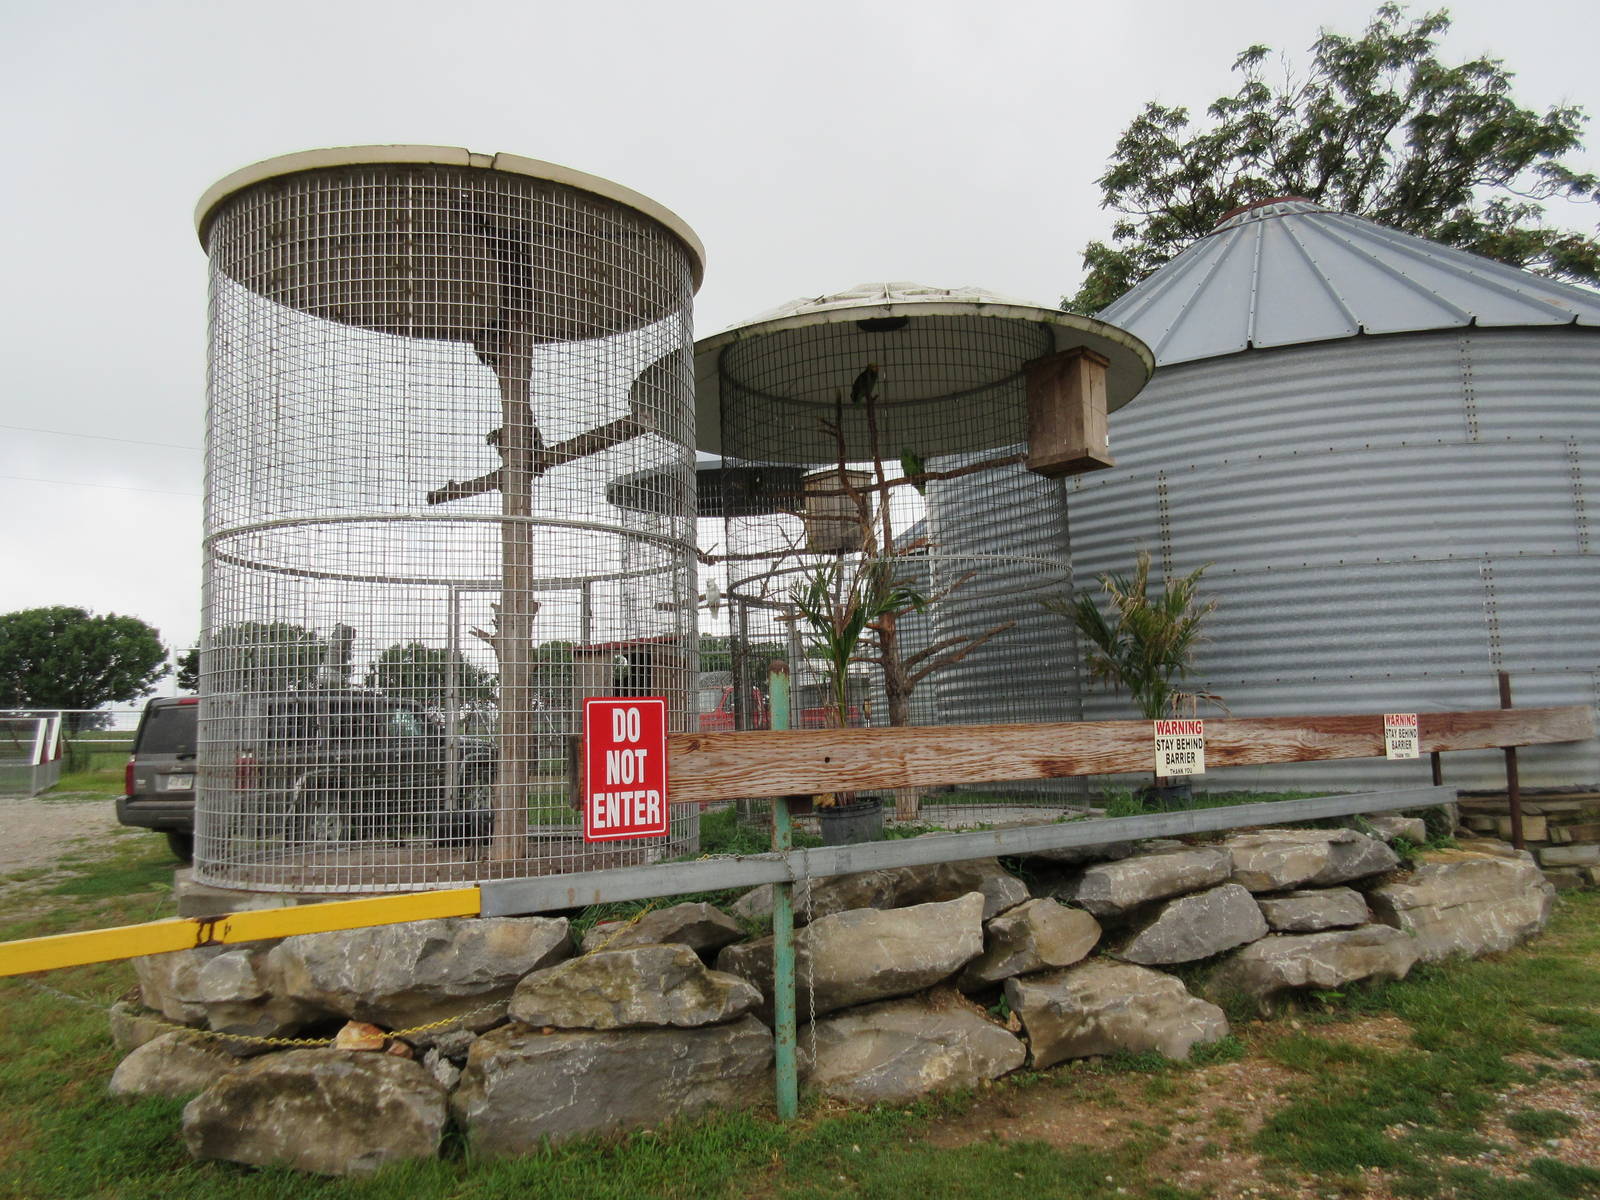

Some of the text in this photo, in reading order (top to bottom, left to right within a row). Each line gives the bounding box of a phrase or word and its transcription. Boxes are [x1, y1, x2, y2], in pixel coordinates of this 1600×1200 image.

[612, 707, 640, 742] DO
[1385, 714, 1416, 726] WARNING
[1156, 721, 1202, 735] WARNING
[1156, 738, 1203, 751] STAY BEHIND
[1166, 752, 1195, 764] BARRIER
[606, 749, 647, 785] NOT
[593, 790, 660, 829] ENTER
